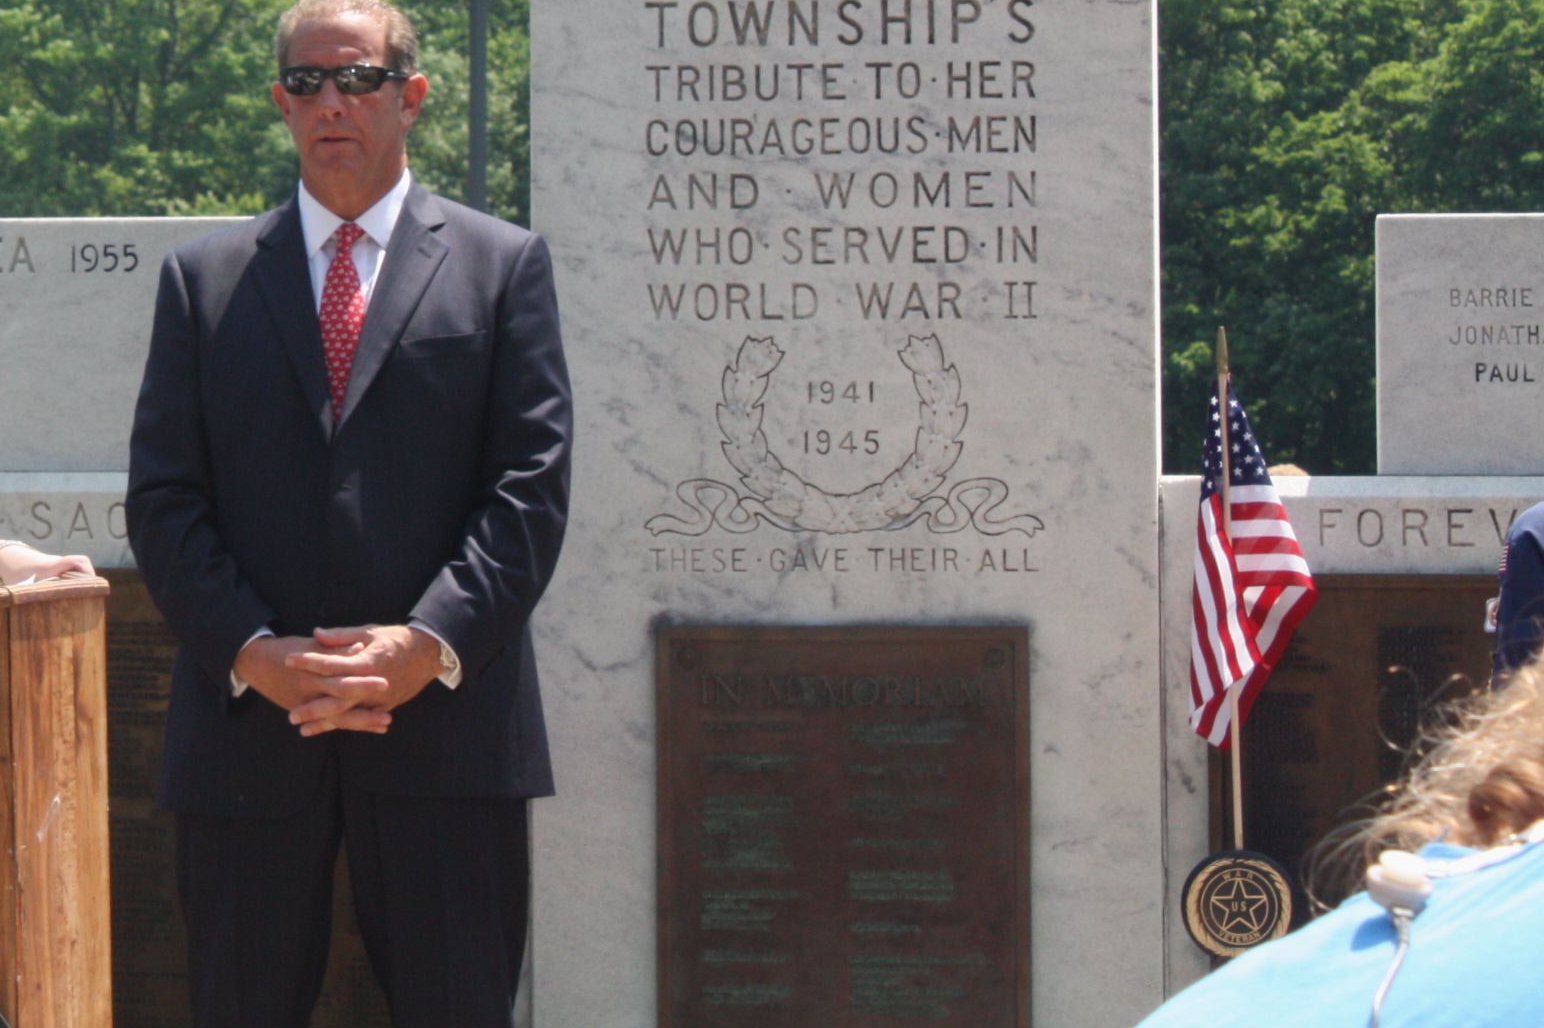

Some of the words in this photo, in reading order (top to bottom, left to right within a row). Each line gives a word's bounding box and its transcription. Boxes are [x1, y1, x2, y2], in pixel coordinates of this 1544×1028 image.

[645, 63, 847, 103] TRIBUTE
[865, 62, 922, 101] TO
[946, 60, 1037, 100] HER
[645, 117, 929, 157] COURAGEOUS
[947, 115, 1038, 154] MEN
[646, 173, 759, 211] AND
[814, 171, 1038, 209] WOMEN
[70, 242, 140, 274] 1955
[646, 228, 754, 266] WHO
[782, 226, 971, 265] SERVED
[995, 225, 1039, 265] IN
[646, 282, 820, 322] WORLD
[855, 281, 963, 321] WAR
[1002, 281, 1039, 320] II
[1449, 287, 1534, 308] BARRIE
[1448, 324, 1544, 345] JONATH
[1474, 362, 1536, 383] PAUL
[806, 380, 877, 405] 1941
[802, 430, 881, 456] 1945
[27, 500, 129, 540] SAC
[1317, 508, 1519, 549] FOREV
[648, 547, 748, 574] THESE
[768, 547, 852, 573] GAVE
[866, 546, 959, 573] THEIR
[978, 546, 1041, 573] ALL
[700, 674, 745, 706] IN
[1222, 870, 1254, 881] WAR
[1231, 900, 1247, 912] US
[1219, 929, 1262, 943] VETERAN
